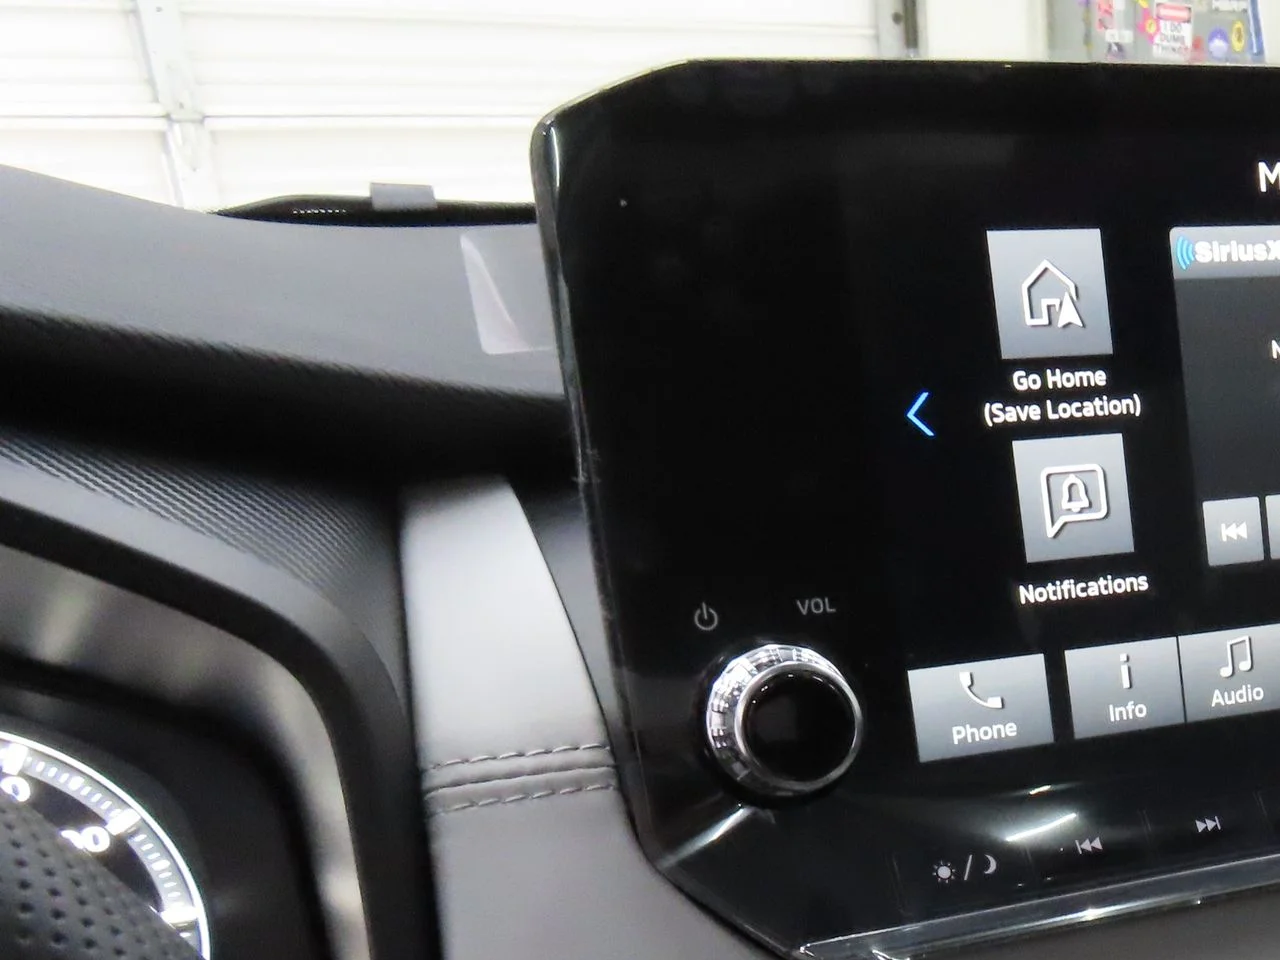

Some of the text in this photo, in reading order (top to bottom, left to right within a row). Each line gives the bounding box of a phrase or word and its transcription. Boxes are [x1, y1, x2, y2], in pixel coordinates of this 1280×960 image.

[1012, 368, 1107, 391] Go Home
[983, 394, 1142, 427] (Save Location)
[1018, 573, 1149, 605] Notifications
[796, 596, 837, 616] VOL
[1210, 683, 1264, 708] Audio
[1108, 700, 1147, 723] Info
[951, 720, 1018, 746] Phone
